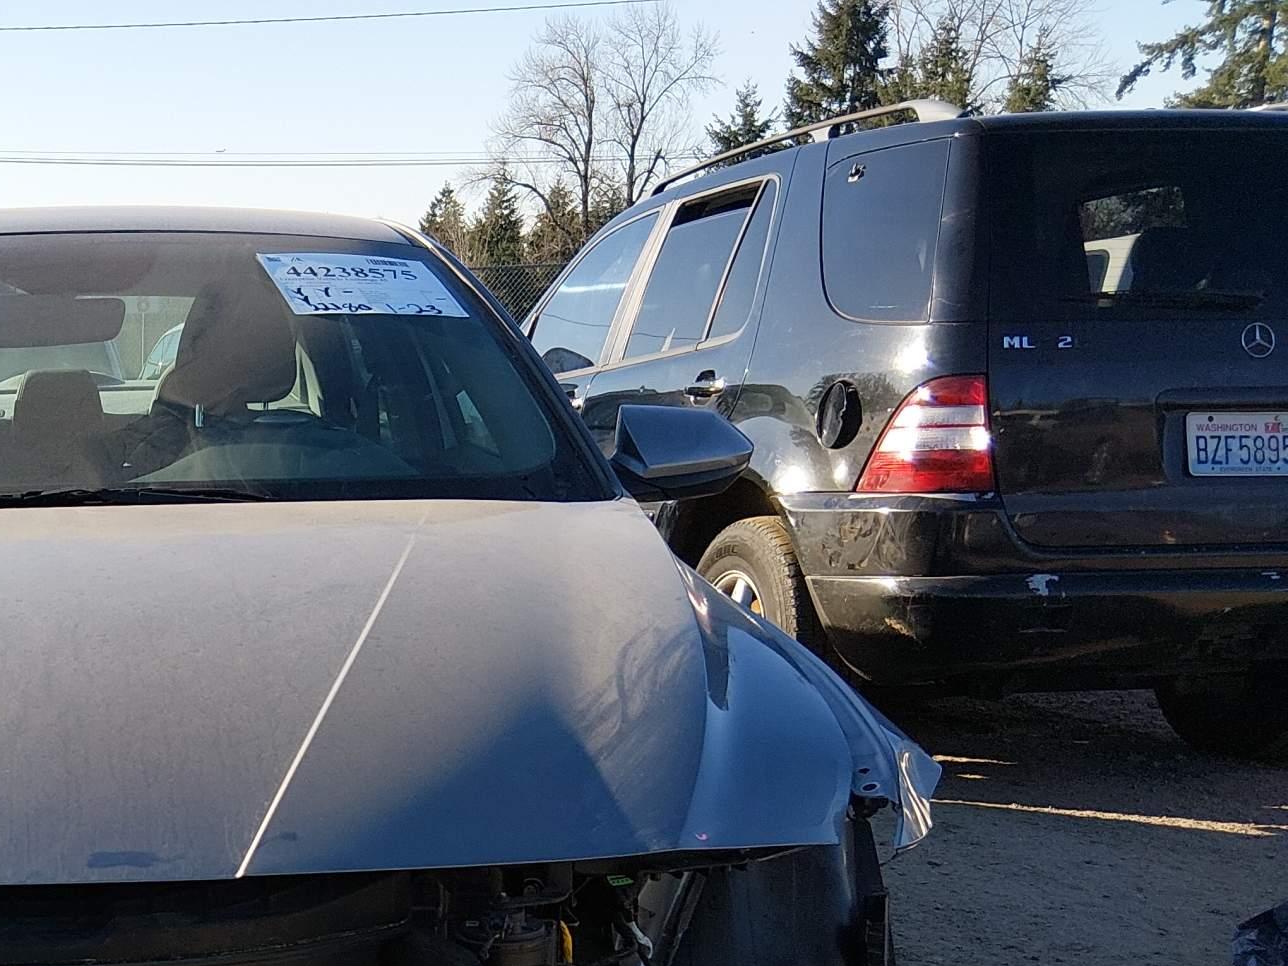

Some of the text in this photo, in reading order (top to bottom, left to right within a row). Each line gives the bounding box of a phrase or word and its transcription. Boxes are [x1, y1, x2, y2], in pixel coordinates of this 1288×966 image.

[286, 266, 418, 281] 44238575
[1003, 336, 1073, 349] ML 2
[1196, 423, 1258, 432] WASHINGTON
